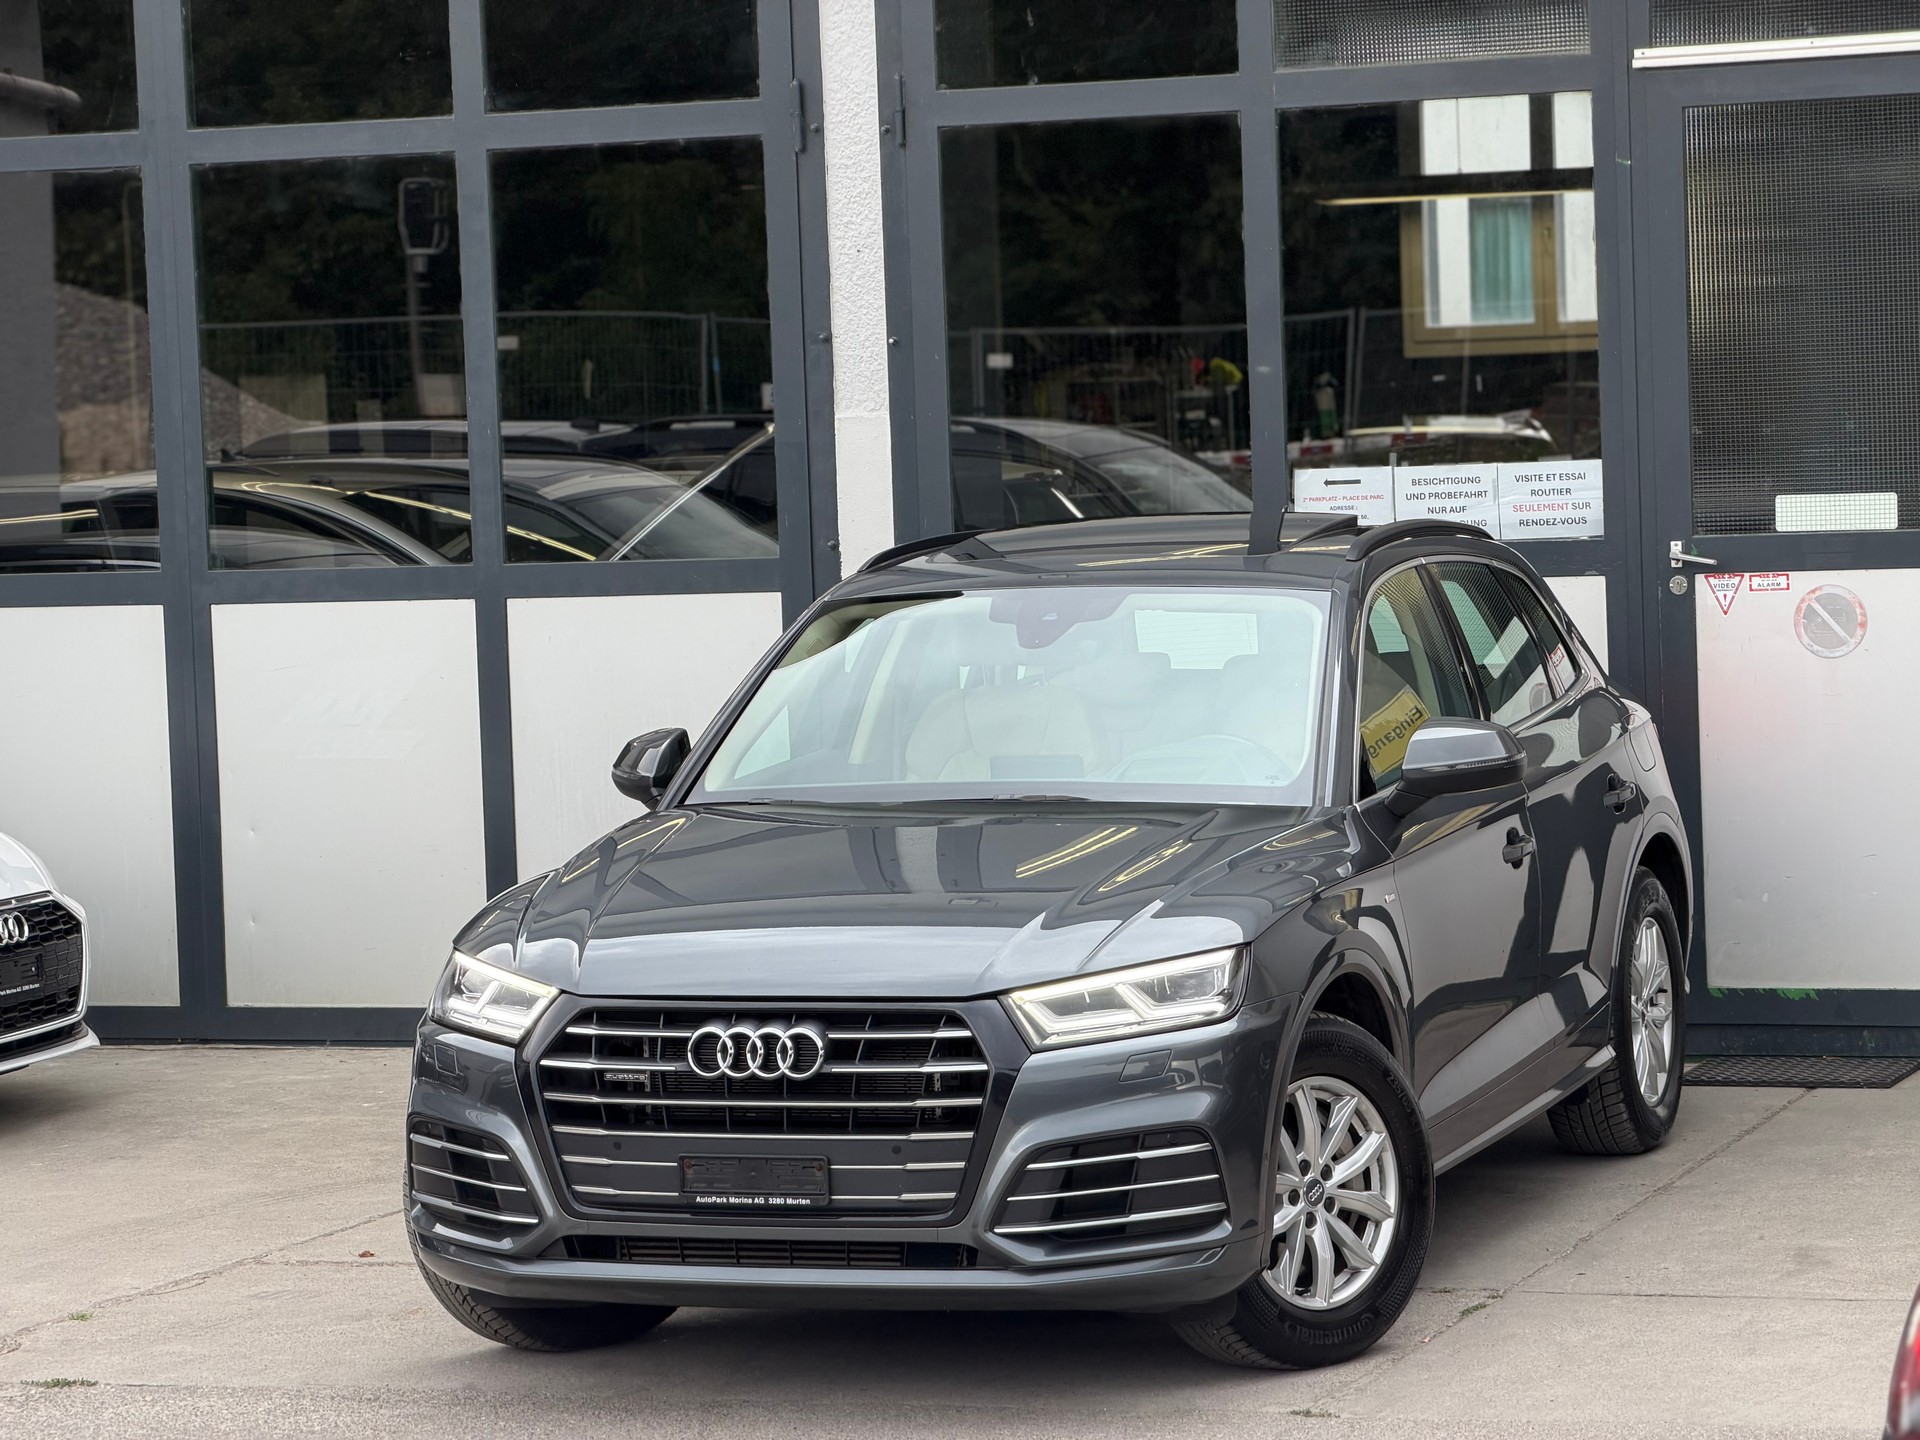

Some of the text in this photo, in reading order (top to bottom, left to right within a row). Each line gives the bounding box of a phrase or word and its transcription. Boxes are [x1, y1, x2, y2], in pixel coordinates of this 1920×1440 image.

[1411, 476, 1481, 486] BESICHTIGUNG
[1514, 472, 1586, 483] VISITE ET ESSAI
[1405, 490, 1488, 501] UND PROBEFAHRT
[1530, 487, 1572, 497] ROUTIER
[1427, 505, 1467, 514] NUR AUF
[1512, 501, 1592, 512] SEULEMENT SUR
[1519, 516, 1588, 527] RENDEZ-VOUS
[695, 1195, 727, 1203] AutoPark
[728, 1196, 752, 1204] Morina
[786, 1197, 811, 1205] Murten
